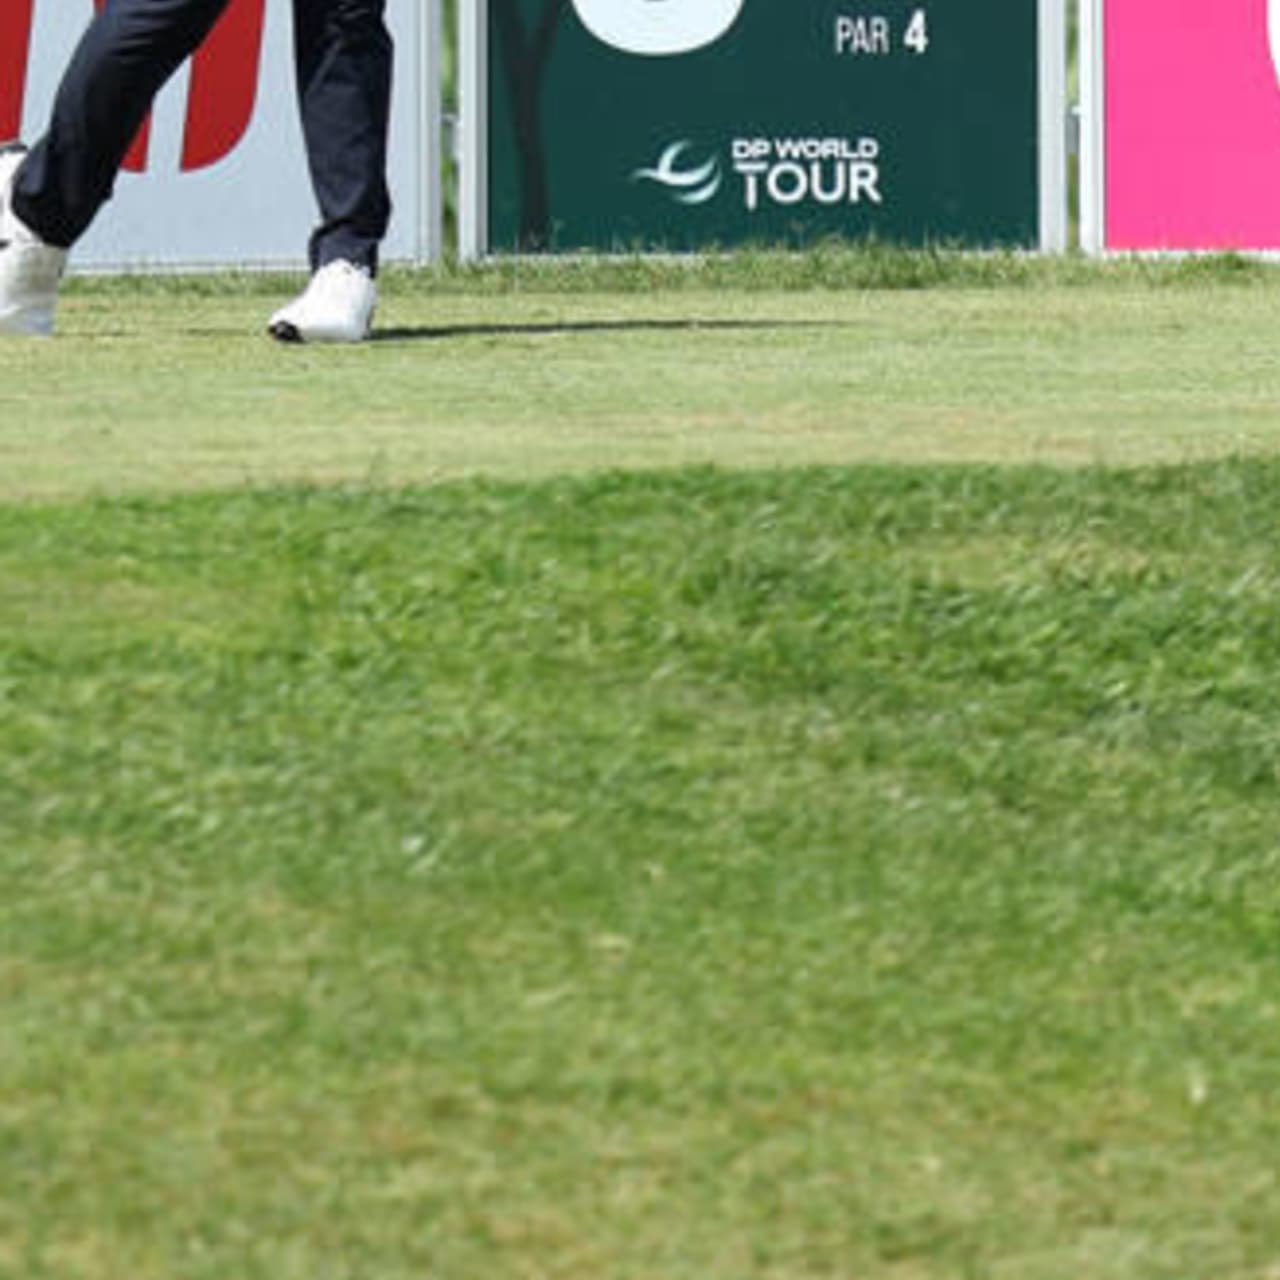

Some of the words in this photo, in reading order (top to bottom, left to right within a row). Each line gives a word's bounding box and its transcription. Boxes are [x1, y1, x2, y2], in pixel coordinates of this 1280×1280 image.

[836, 16, 889, 54] PAR
[903, 8, 929, 53] 4
[732, 139, 770, 159] DP
[776, 139, 880, 159] WORLD
[733, 161, 883, 210] TOUR
